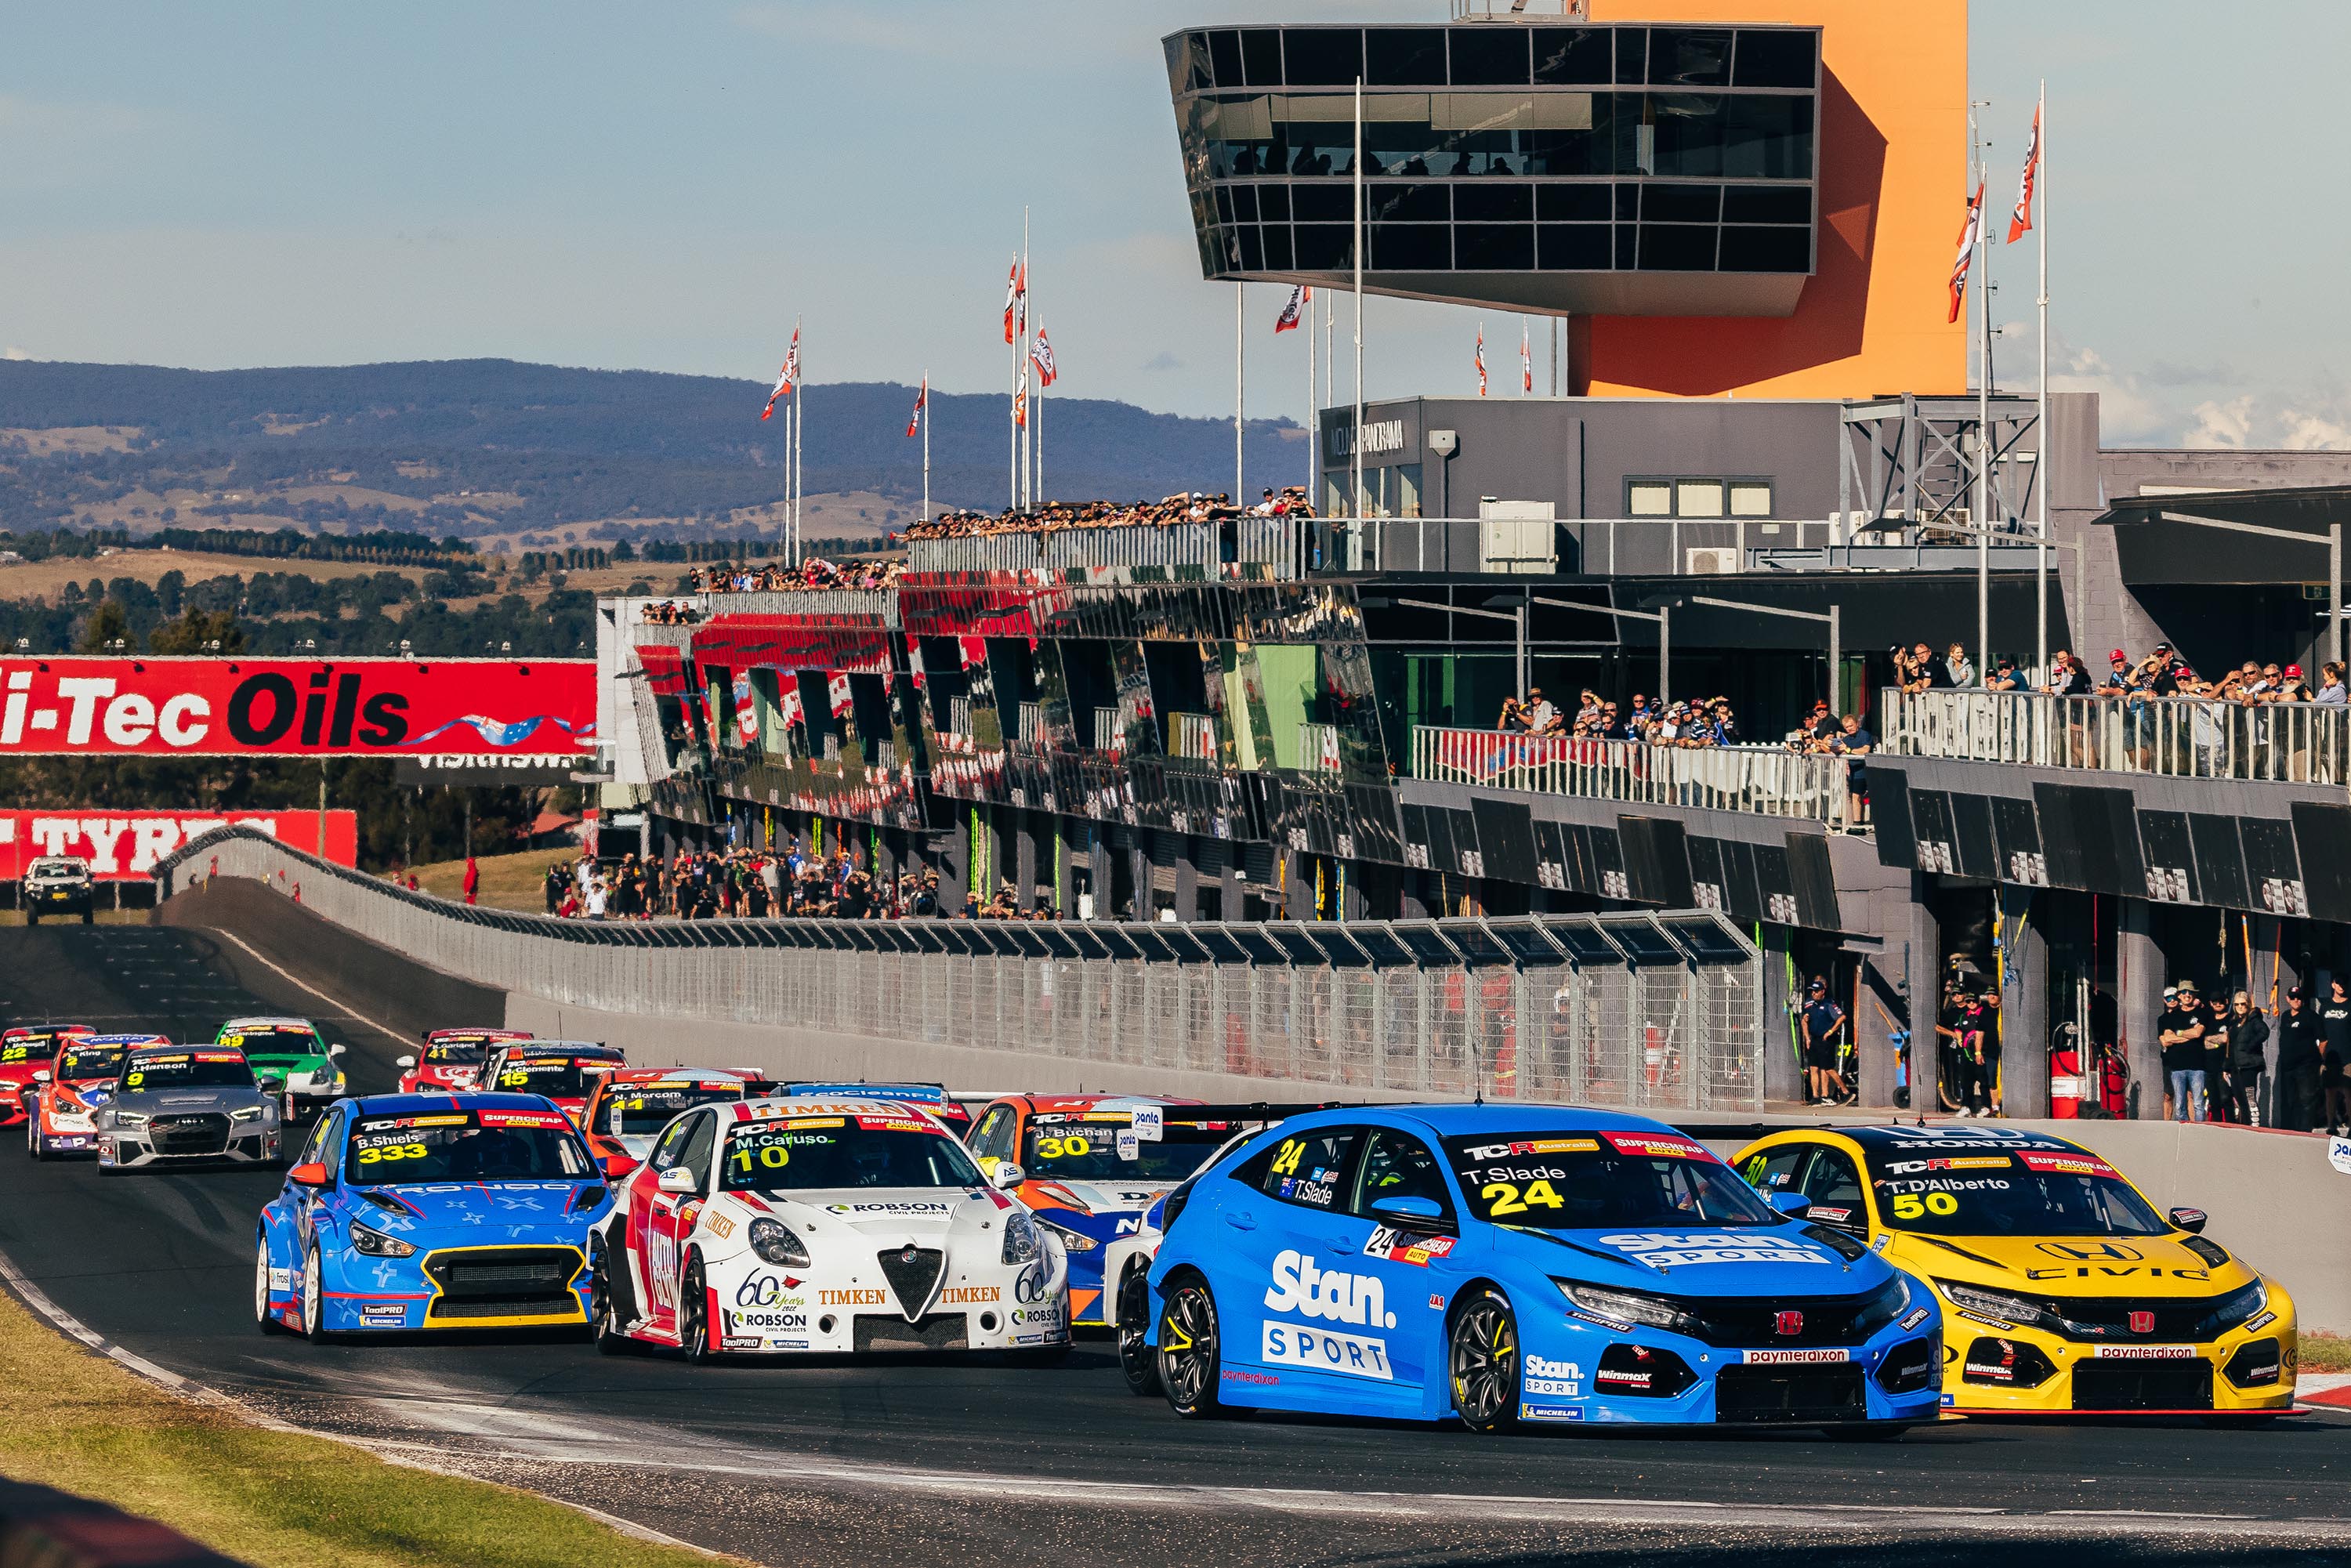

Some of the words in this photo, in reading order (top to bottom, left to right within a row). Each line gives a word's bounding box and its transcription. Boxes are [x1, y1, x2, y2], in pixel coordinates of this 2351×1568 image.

[1361, 419, 1403, 453] PANORAMA
[0, 671, 210, 746] i-Tec
[228, 672, 410, 747] Oils
[2, 1047, 27, 1061] 22
[66, 1056, 78, 1066] 2
[427, 1048, 447, 1059] 41
[129, 1063, 188, 1073] J.Hanson
[127, 1073, 144, 1086] 9
[499, 1071, 529, 1087] 15
[607, 1082, 650, 1092] TCR
[752, 1103, 907, 1118] TIMKEN
[1031, 1114, 1086, 1125] TCR
[1135, 1111, 1159, 1125] panta
[360, 1117, 416, 1132] TCR
[417, 1116, 465, 1124] Australia
[484, 1114, 563, 1124] SUPERCHEAP
[730, 1120, 790, 1137] TCR
[791, 1119, 842, 1128] Australia
[357, 1133, 420, 1150] B.Shiels
[736, 1133, 829, 1150] M.Caruso
[1053, 1128, 1114, 1138] Buchan
[1038, 1136, 1090, 1159] 30
[1464, 1140, 1538, 1161] TCR
[1538, 1139, 1596, 1150] Australia
[1614, 1138, 1704, 1155] SUPERCHEAP
[1891, 1140, 2067, 1149] HONDA
[358, 1143, 429, 1165] 333
[732, 1146, 790, 1172] 10
[1271, 1139, 1307, 1175] 24
[1743, 1155, 1768, 1187] 50
[1885, 1158, 1954, 1175] TCR
[2028, 1156, 2114, 1172] SUPERCHEAP
[1462, 1165, 1567, 1186] T.Slade
[395, 1183, 572, 1194] RONDO
[1295, 1179, 1333, 1205] T.Slade
[1886, 1181, 1906, 1194] T.
[1909, 1178, 2010, 1193] D'Alberto
[1482, 1179, 1566, 1217] 24
[1893, 1192, 1958, 1220] 50
[853, 1203, 949, 1212] ROBSON
[705, 1209, 737, 1240] TIMKEN
[1366, 1227, 1398, 1255] 24
[1599, 1233, 1823, 1251] Stan.
[1408, 1251, 1426, 1260] AUTO
[1643, 1250, 1824, 1264] SPORT
[276, 1271, 290, 1284] frost
[2027, 1266, 2211, 1281] CIVIC
[736, 1267, 780, 1308] 60
[1015, 1263, 1045, 1305] 60
[1263, 1249, 1397, 1330] Stan.
[766, 1291, 806, 1310] Years
[818, 1289, 887, 1305] TIMKEN
[940, 1286, 1001, 1304] TIMKEN
[364, 1305, 405, 1316] ToolPRO
[1900, 1309, 1929, 1330] ToolPRO
[746, 1314, 807, 1327] ROBSON
[1572, 1311, 1630, 1331] ToolPRO
[1960, 1311, 2012, 1331] ToolPRO
[2247, 1313, 2276, 1332] ToolPRO
[721, 1338, 759, 1348] ToolPRO
[1268, 1328, 1383, 1371] SPORT
[2102, 1346, 2193, 1359] paynterdixon
[1526, 1354, 1585, 1380] Stan.
[1223, 1370, 1281, 1386] paynterdixon
[1526, 1380, 1576, 1394] SPORT
